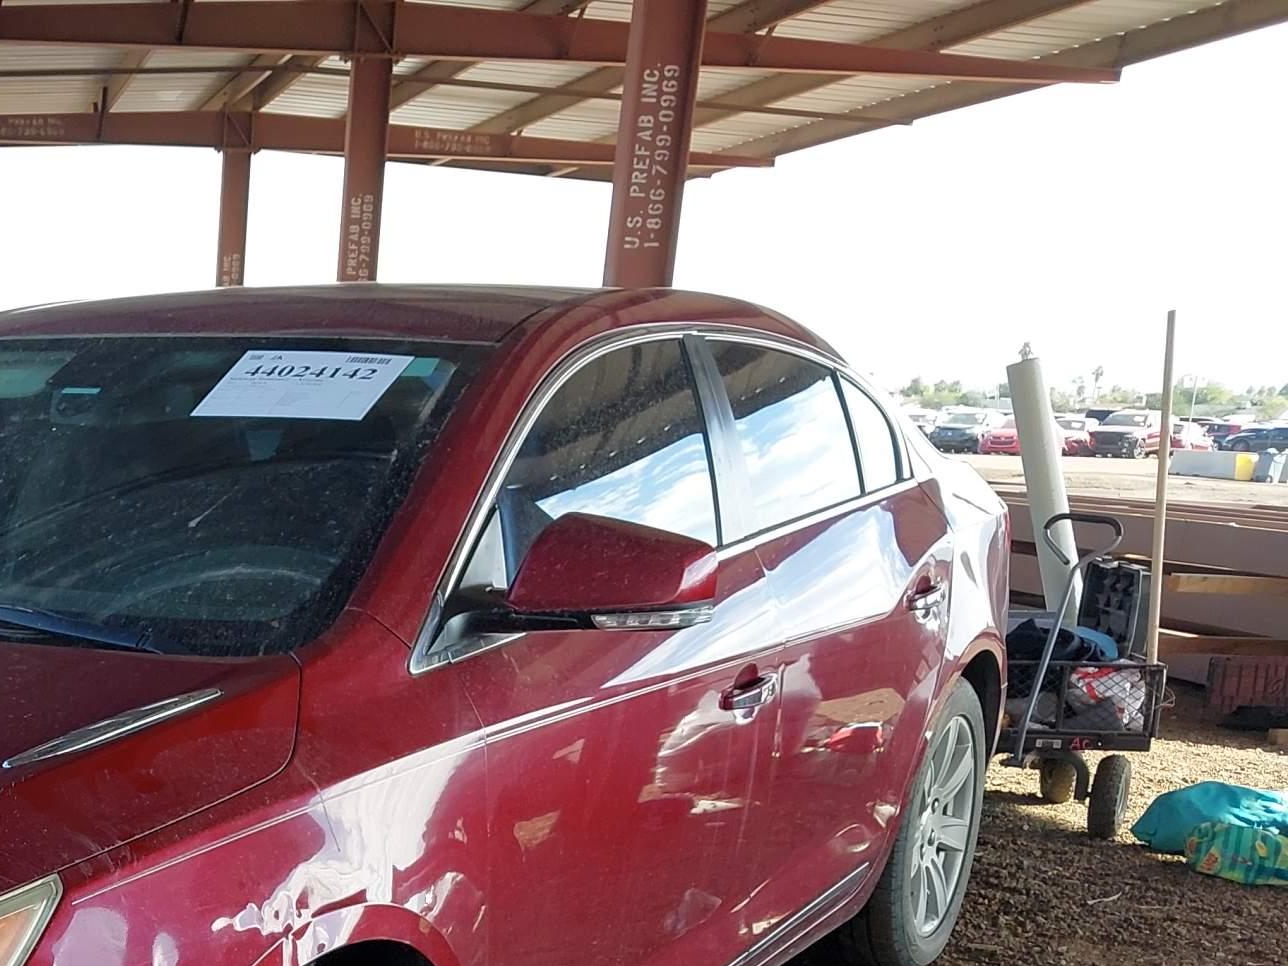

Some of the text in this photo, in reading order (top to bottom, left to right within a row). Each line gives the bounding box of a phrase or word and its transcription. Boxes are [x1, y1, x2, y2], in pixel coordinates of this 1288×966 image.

[624, 62, 661, 249] U.S. PREFAB INC.
[643, 64, 680, 248] 1-866-799-0969
[346, 224, 360, 275] PREFAB
[244, 364, 378, 380] 44024142
